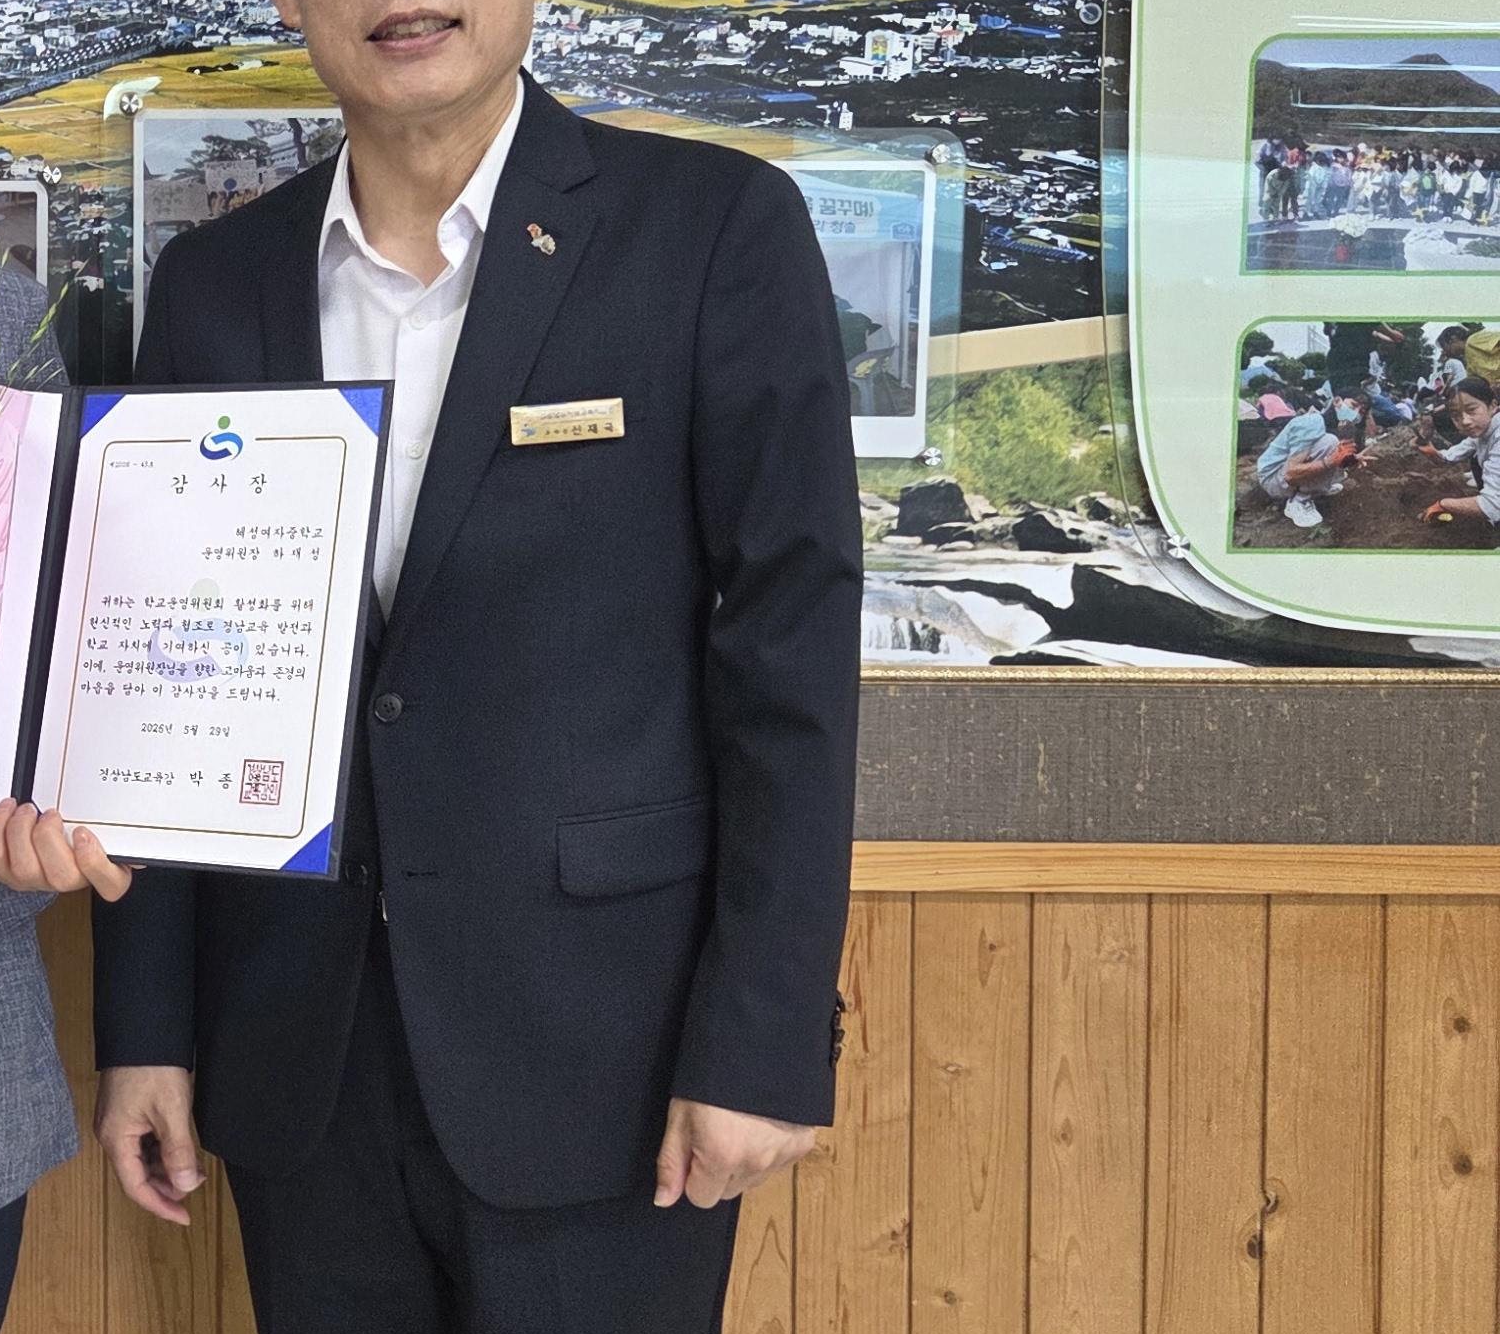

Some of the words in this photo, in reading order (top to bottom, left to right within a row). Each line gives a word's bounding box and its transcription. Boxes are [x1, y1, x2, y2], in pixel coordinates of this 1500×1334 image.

[201, 547, 260, 561] 운영위원장
[101, 595, 135, 608] 귀하는
[144, 596, 224, 610] 학교운영위원회
[234, 596, 282, 611] 활성화를
[291, 597, 314, 611] 위해
[90, 617, 132, 630] 헌신적인
[140, 617, 173, 631] 노력과
[182, 619, 214, 631] 협조로
[223, 620, 268, 634] 경남교육
[277, 621, 312, 634] 발전과
[87, 638, 108, 651] 학교
[118, 639, 152, 652] 자치에
[163, 640, 210, 654] 기여하신
[221, 642, 244, 655] 공이
[255, 643, 309, 657] 있습니다.
[114, 661, 187, 677] 운영위원장님을
[195, 662, 216, 677] 향한
[222, 665, 267, 679] 고마움과
[273, 666, 305, 679] 존경의
[81, 683, 115, 696] 마음을
[123, 683, 145, 696] 담아
[152, 684, 163, 695] 이
[172, 685, 218, 699] 감사장을
[227, 687, 281, 702] 드립니다.
[100, 768, 175, 786] 경상남도교육감
